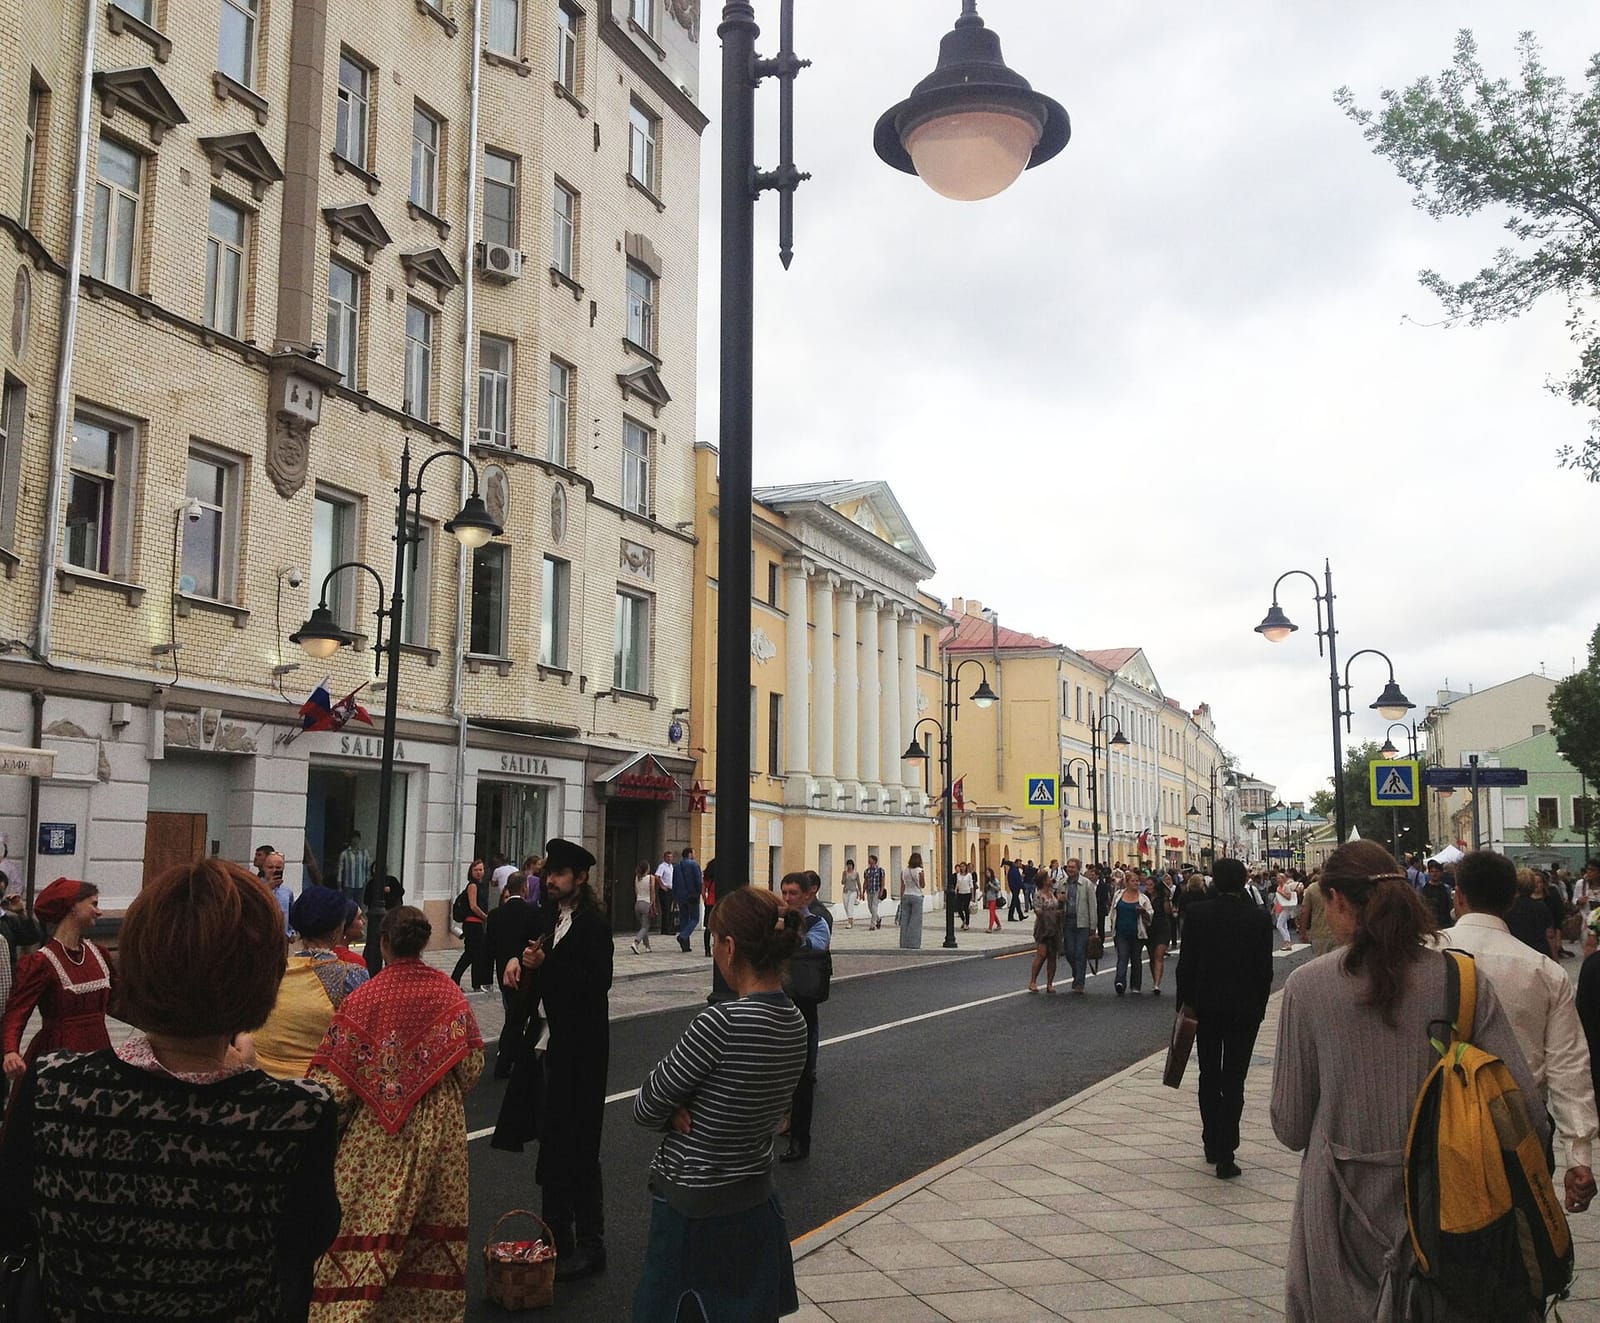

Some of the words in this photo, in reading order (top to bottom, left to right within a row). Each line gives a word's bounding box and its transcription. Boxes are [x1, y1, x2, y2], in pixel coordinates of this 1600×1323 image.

[341, 735, 405, 759] SALIA
[3, 759, 30, 771] КАФЕ
[501, 755, 548, 775] SALITA
